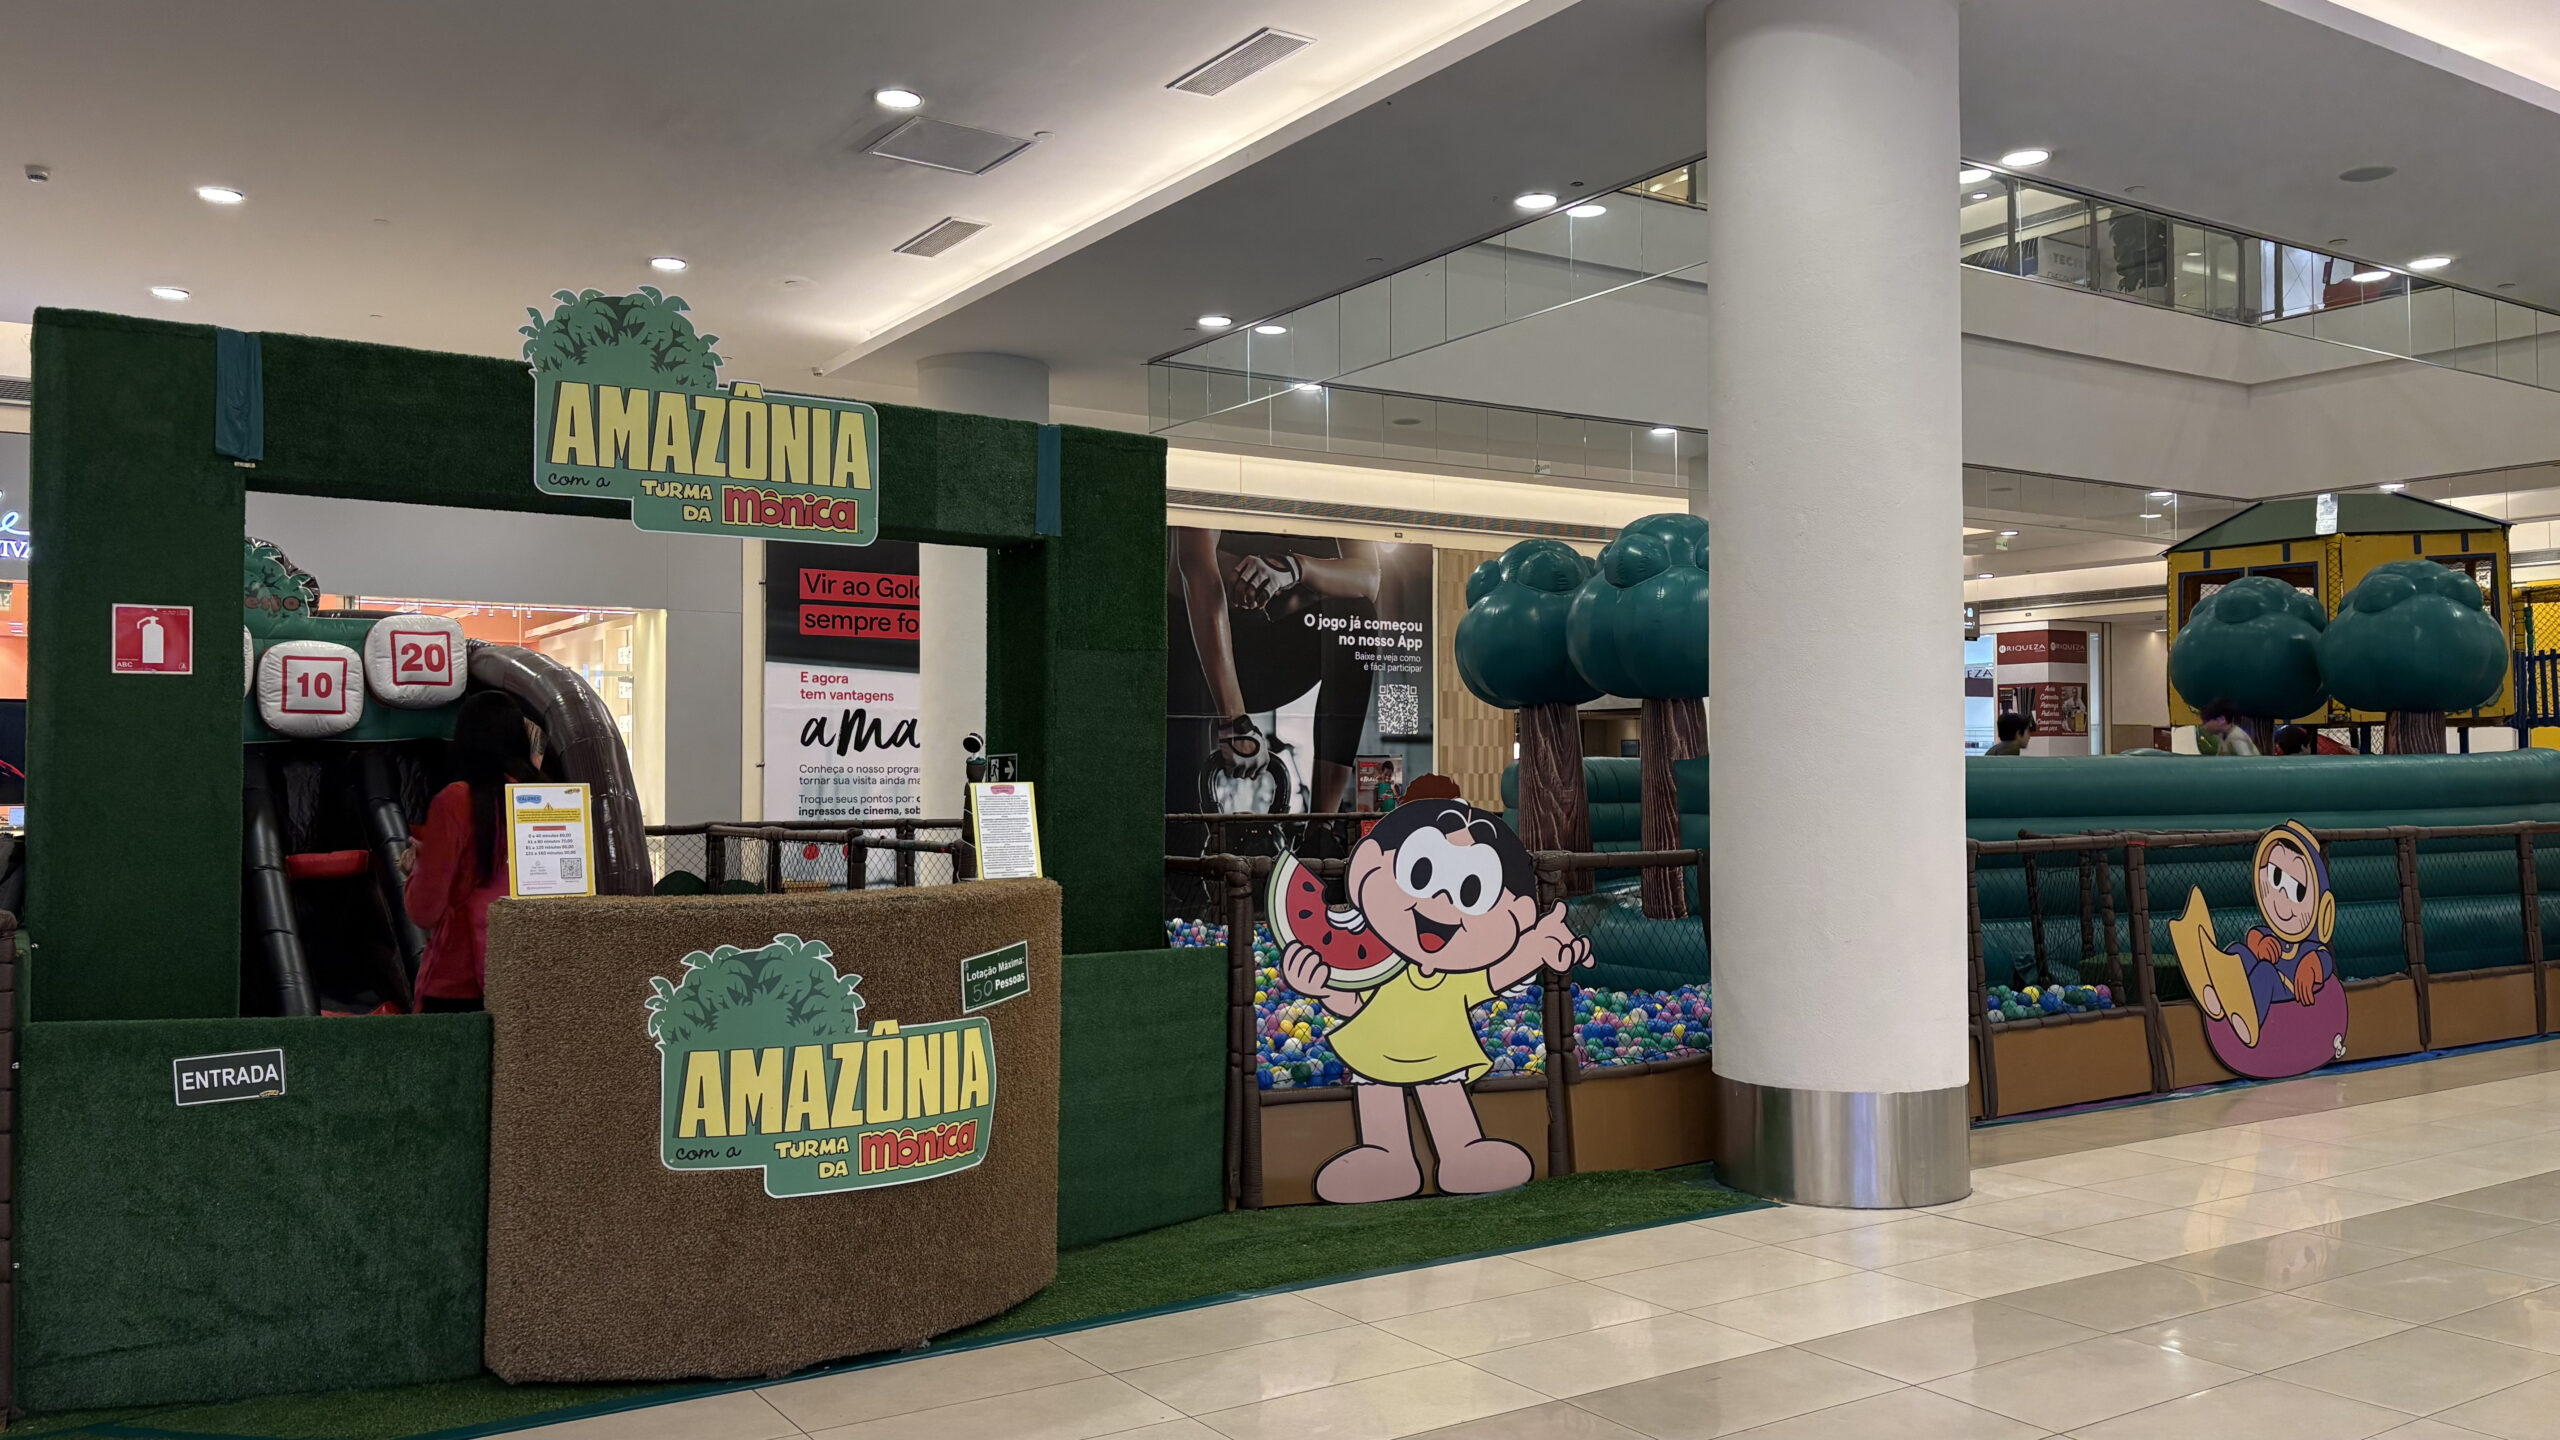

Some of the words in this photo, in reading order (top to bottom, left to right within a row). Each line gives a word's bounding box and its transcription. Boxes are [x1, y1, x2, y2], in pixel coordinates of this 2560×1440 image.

[548, 380, 873, 490] AMAZÔNIA
[548, 470, 591, 487] com
[596, 475, 612, 488] a
[640, 479, 713, 501] TURMA
[682, 504, 713, 523] DA
[804, 573, 837, 594] Vir
[842, 580, 870, 596] ao
[804, 613, 891, 635] sempre
[1304, 613, 1316, 627] O
[1317, 613, 1347, 631] jogo
[1348, 615, 1361, 632] já
[1364, 619, 1423, 633] começou
[1338, 635, 1355, 646] no
[1358, 636, 1395, 647] nosso
[1397, 635, 1423, 651] App
[401, 643, 446, 672] 20
[1355, 652, 1375, 661] Baixe
[1383, 653, 1398, 663] veja
[1399, 654, 1421, 662] como
[1363, 662, 1369, 671] é
[1370, 662, 1386, 672] fácil
[1387, 663, 1423, 673] participar
[297, 672, 333, 698] 10
[800, 671, 809, 683] E
[812, 674, 849, 686] agora
[800, 688, 826, 700] tem
[830, 690, 895, 703] vantagens
[799, 764, 844, 775] Conheça
[847, 766, 854, 774] o
[856, 766, 884, 774] nosso
[887, 766, 920, 776] progra
[799, 777, 829, 785] tornar
[833, 777, 850, 785] sua
[853, 776, 877, 785] visita
[879, 776, 905, 785] ainda
[799, 794, 834, 806] Troque
[835, 795, 858, 804] seus
[860, 795, 893, 805] pontos
[896, 796, 914, 806] por:
[799, 806, 846, 817] ingressos
[848, 806, 860, 815] de
[863, 806, 902, 816] cinema,
[966, 965, 997, 982] Lotação
[998, 957, 1025, 973] Máxima:
[973, 980, 994, 1002] 50
[995, 973, 1026, 991] Pessoas
[182, 1063, 279, 1091] ENTRADA
[677, 1019, 990, 1139] AMAZÔNIA
[676, 1146, 719, 1160] com
[726, 1146, 742, 1158] a
[774, 1136, 849, 1159] TURMA
[818, 1160, 849, 1179] DA
